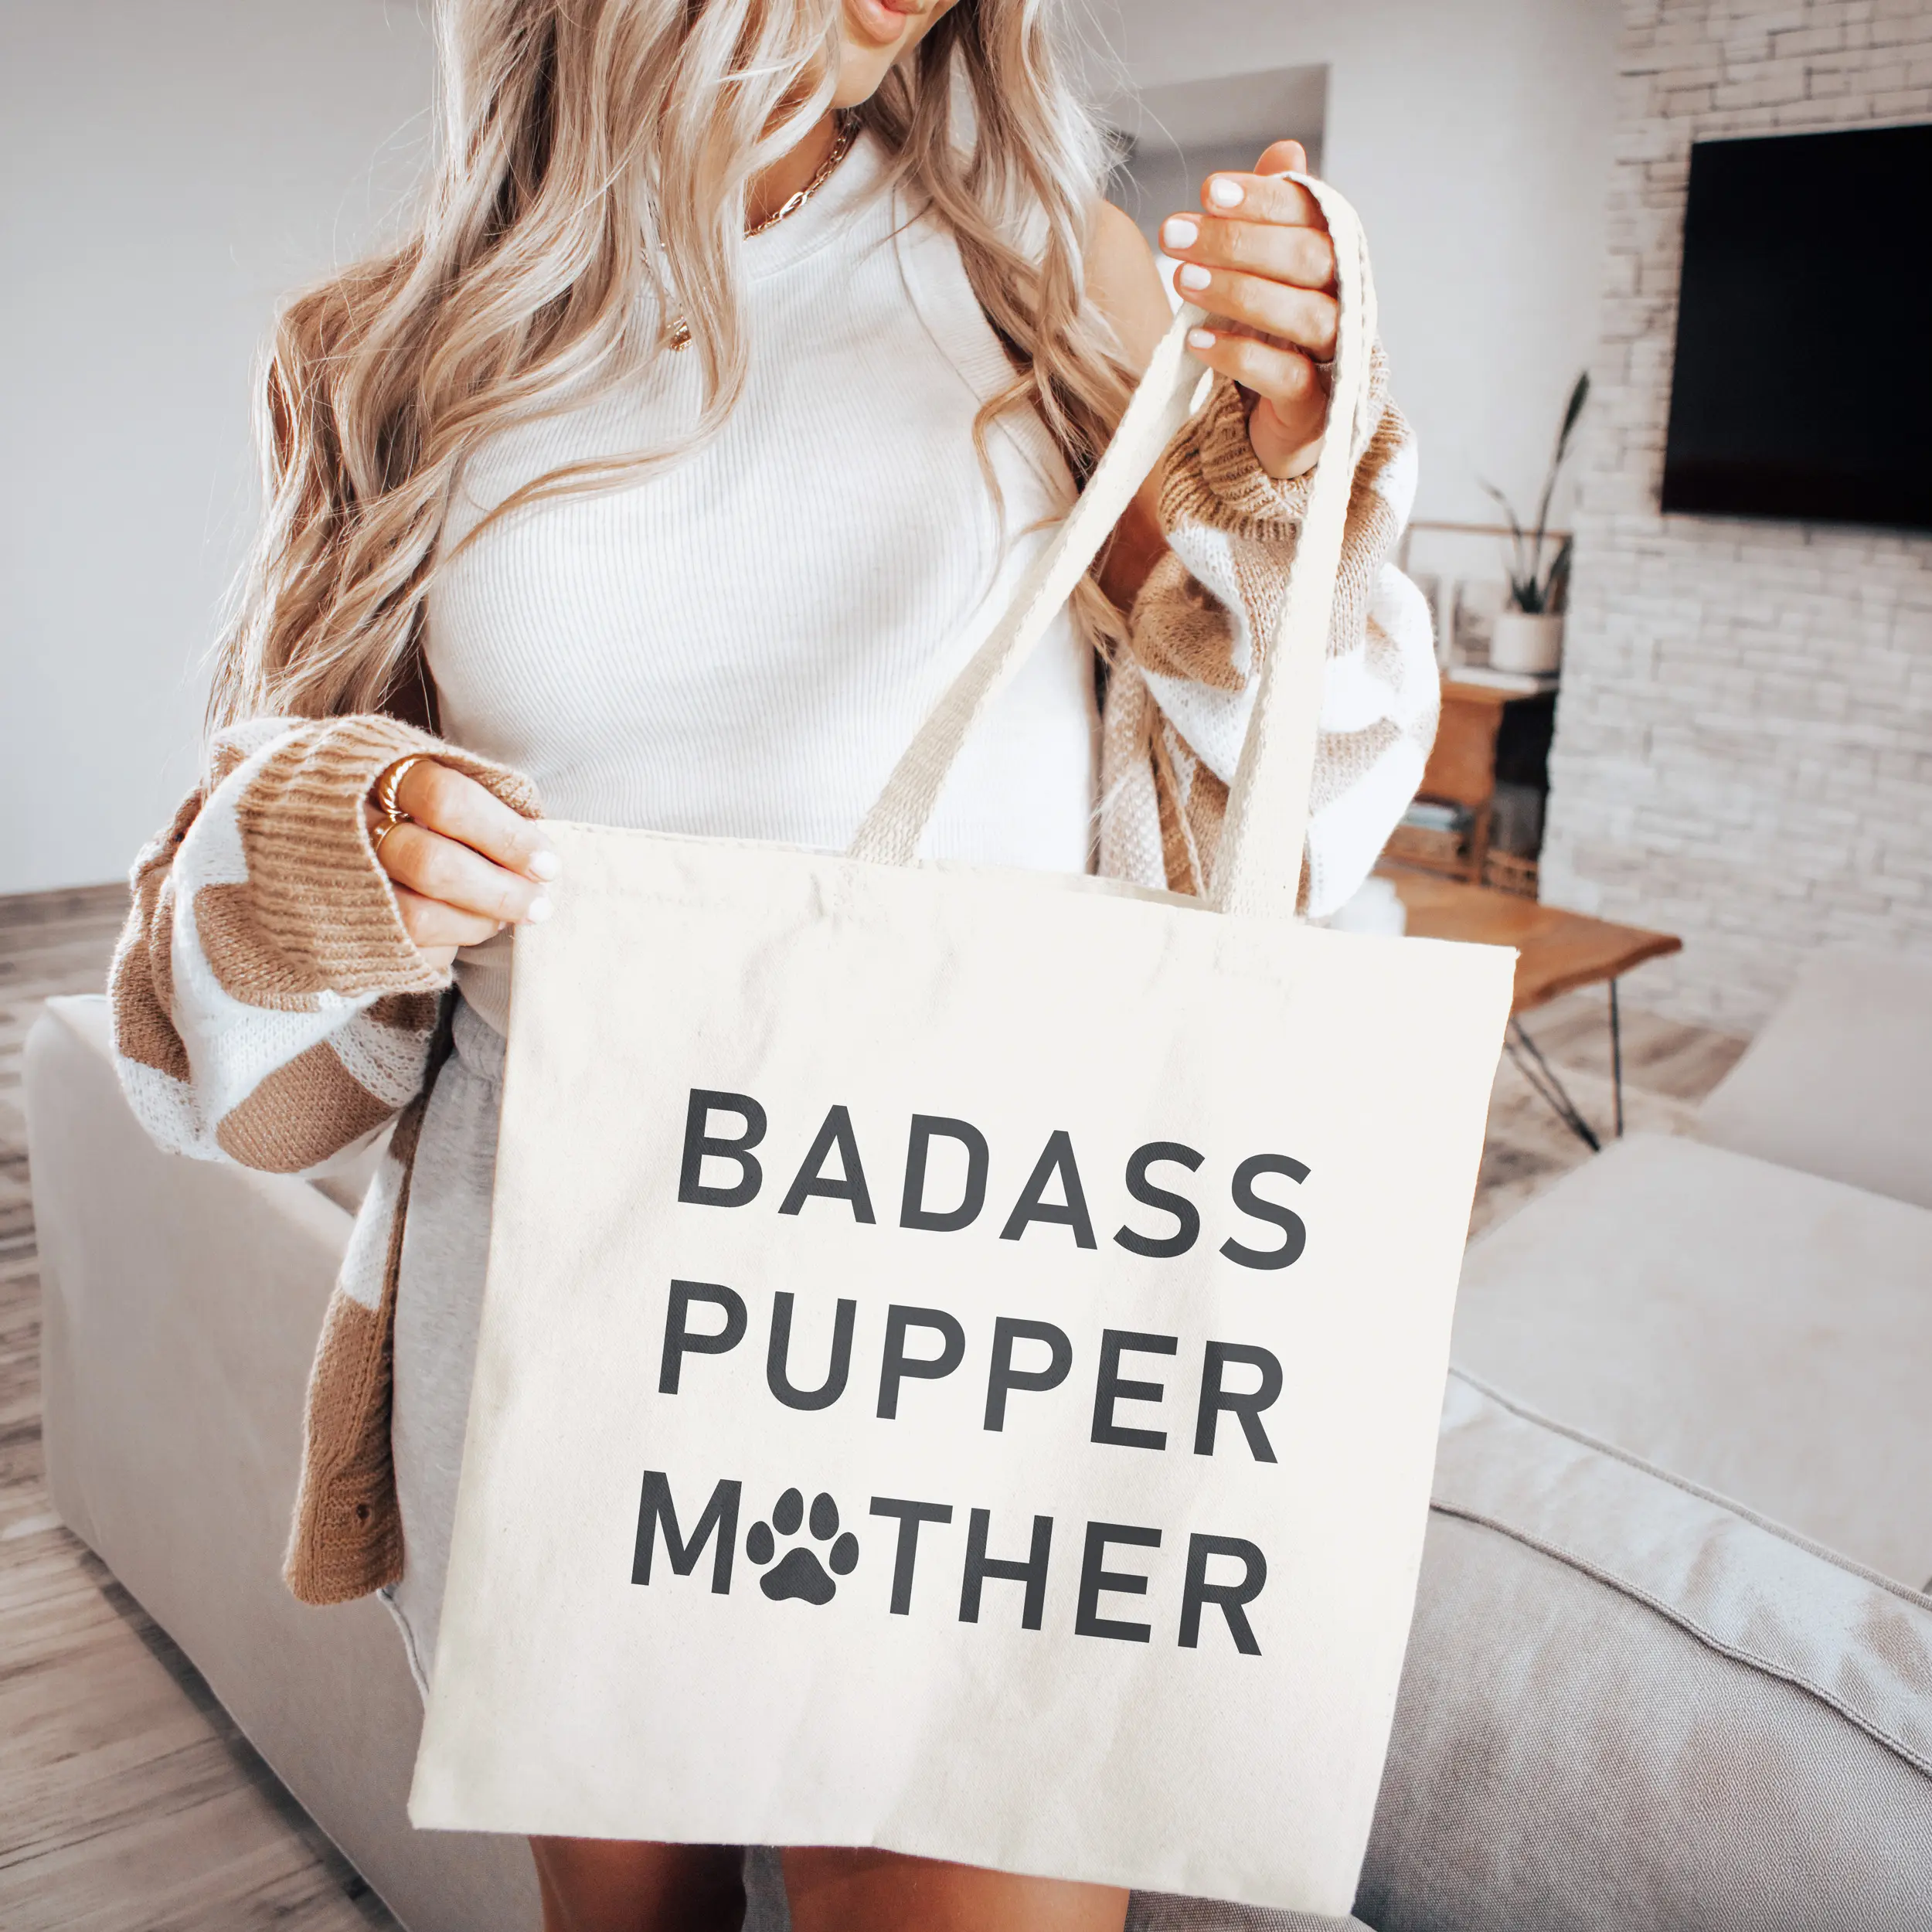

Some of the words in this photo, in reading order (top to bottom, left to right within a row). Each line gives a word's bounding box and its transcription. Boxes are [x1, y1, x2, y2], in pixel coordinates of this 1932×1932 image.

[677, 1088, 1311, 1270] BADASS
[658, 1279, 1284, 1464] PUPPER
[631, 1470, 1267, 1656] MTHER
